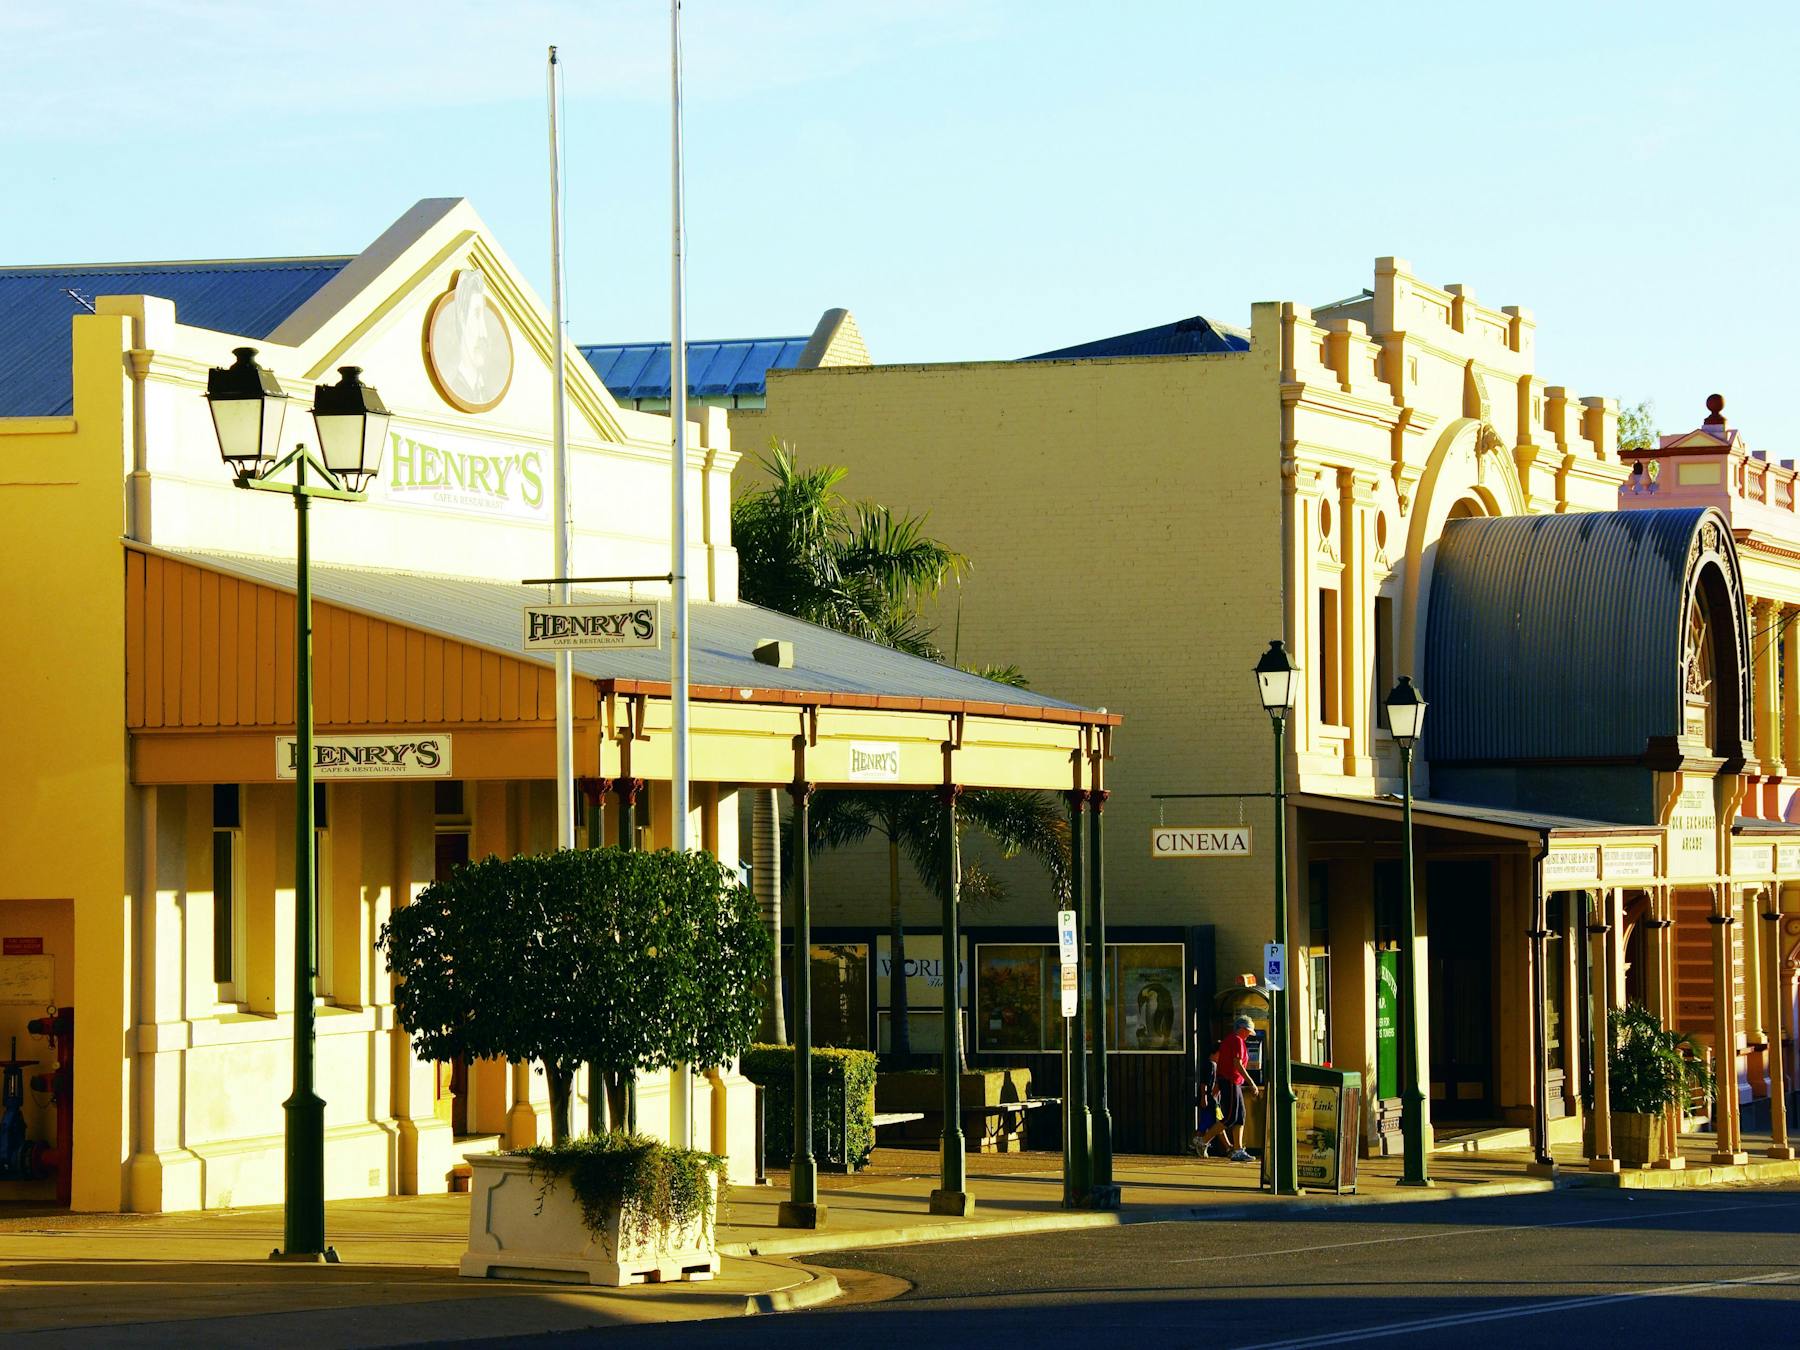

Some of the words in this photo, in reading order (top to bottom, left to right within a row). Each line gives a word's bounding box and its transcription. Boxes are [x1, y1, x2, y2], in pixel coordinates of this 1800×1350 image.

[389, 431, 544, 510] HENRY'S
[528, 609, 654, 641] HENRY'S
[579, 637, 625, 645] RESTAURANT
[851, 748, 898, 775] HENRY'S
[1156, 832, 1247, 852] CINEMA
[1063, 913, 1071, 926] P
[1270, 946, 1279, 957] P
[1313, 1101, 1334, 1111] Link
